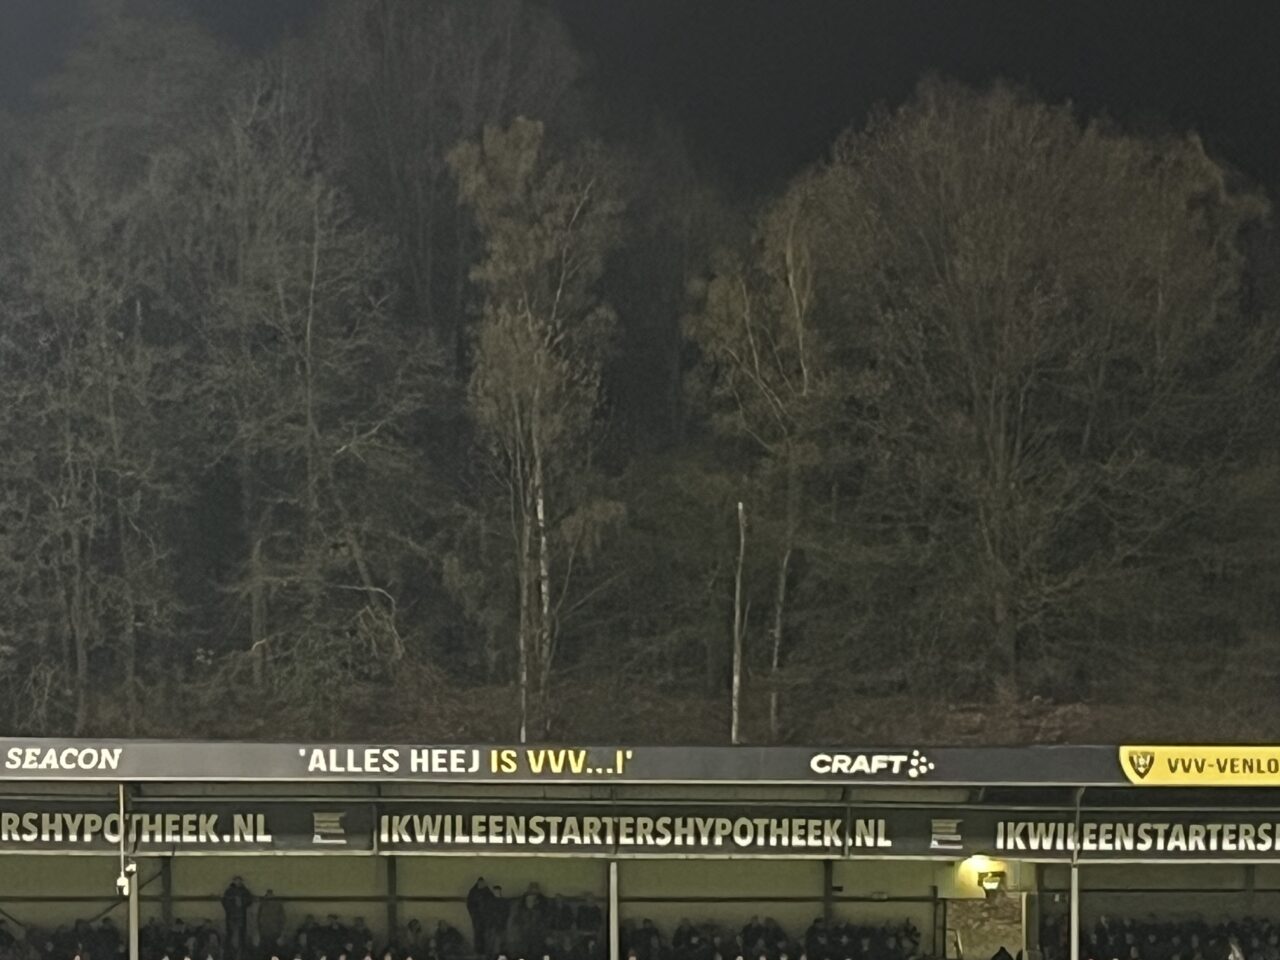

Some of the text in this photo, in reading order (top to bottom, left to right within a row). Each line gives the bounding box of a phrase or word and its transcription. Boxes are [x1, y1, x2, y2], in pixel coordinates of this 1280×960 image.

[5, 748, 123, 769] SEACON
[410, 750, 480, 772] HEEJ
[490, 750, 517, 772] IS
[810, 754, 908, 774] CRAFT
[1167, 757, 1280, 774] VVV-VENLO
[380, 814, 892, 848] IKWILEENSTARTERSHYPOTHEEK.NL
